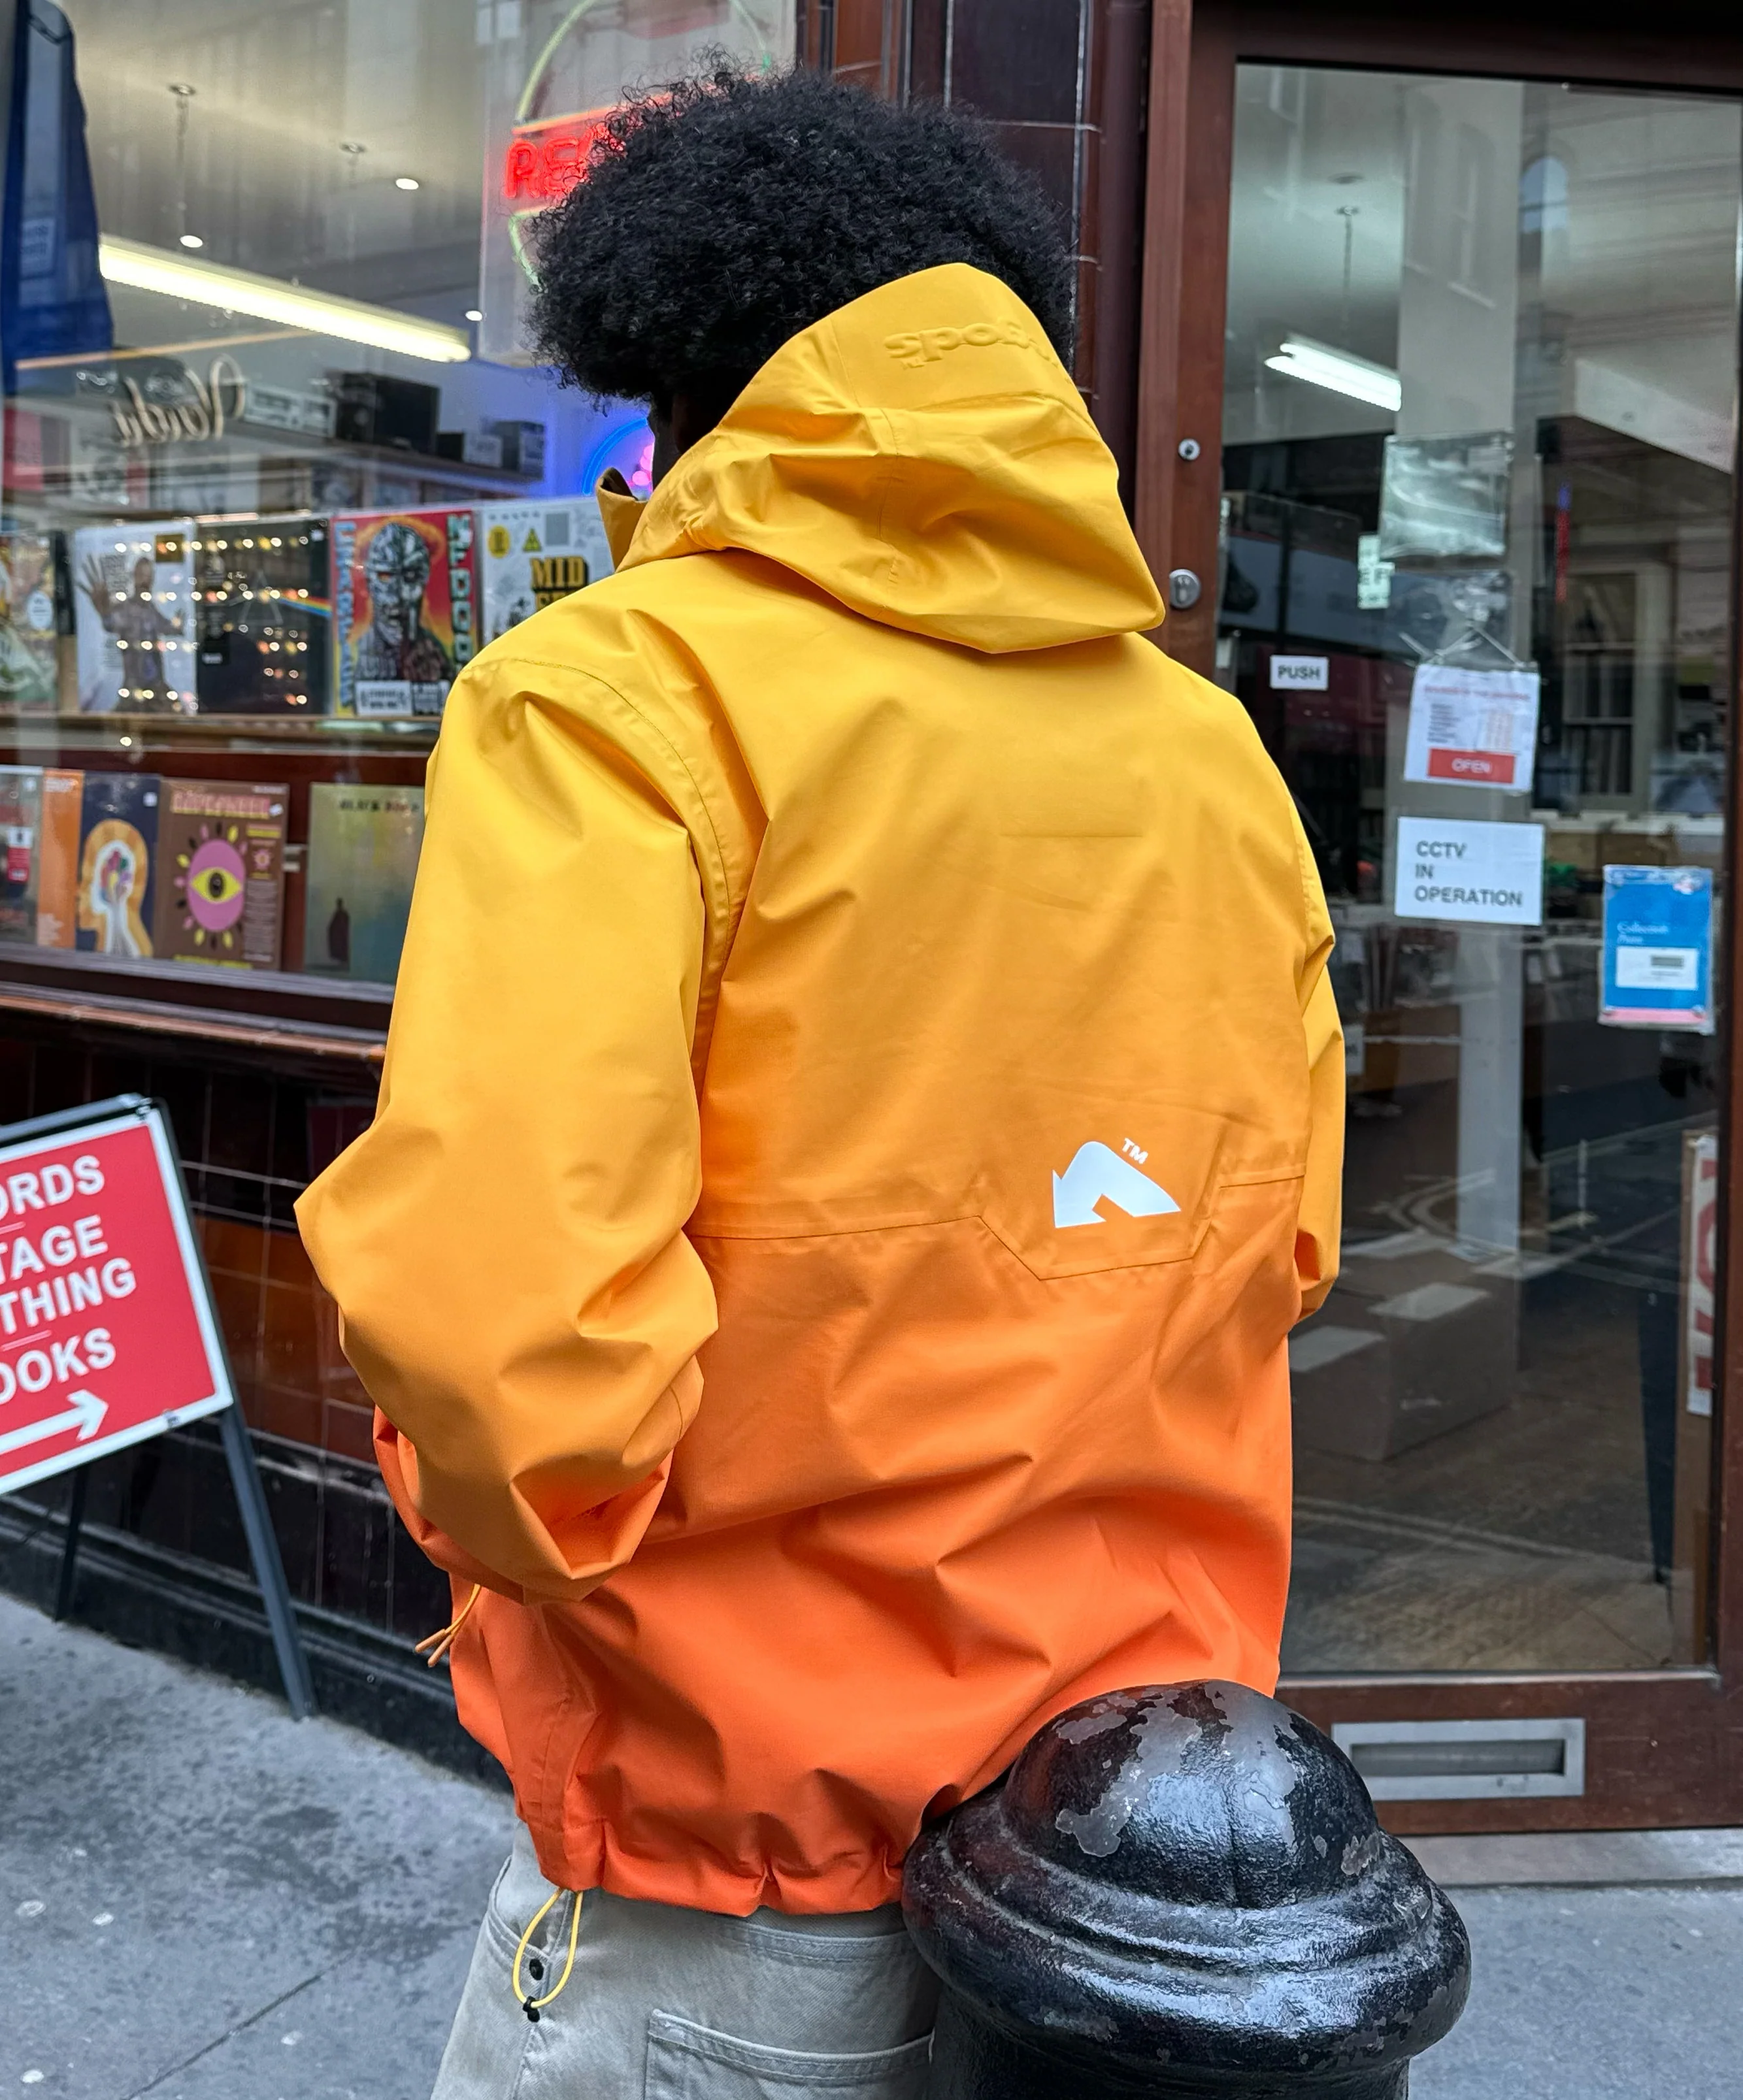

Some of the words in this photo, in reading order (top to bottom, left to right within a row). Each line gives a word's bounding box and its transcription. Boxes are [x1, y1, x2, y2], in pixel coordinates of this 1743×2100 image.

[531, 557, 589, 591] MID
[1278, 664, 1320, 680] PUSH
[1451, 757, 1493, 774] OPEN
[1416, 840, 1468, 859] CCTV
[1415, 863, 1435, 879] IN
[1414, 885, 1524, 908] OPERATION
[1121, 1137, 1149, 1165] TM
[0, 1155, 105, 1221] RDS
[0, 1257, 137, 1335] THING
